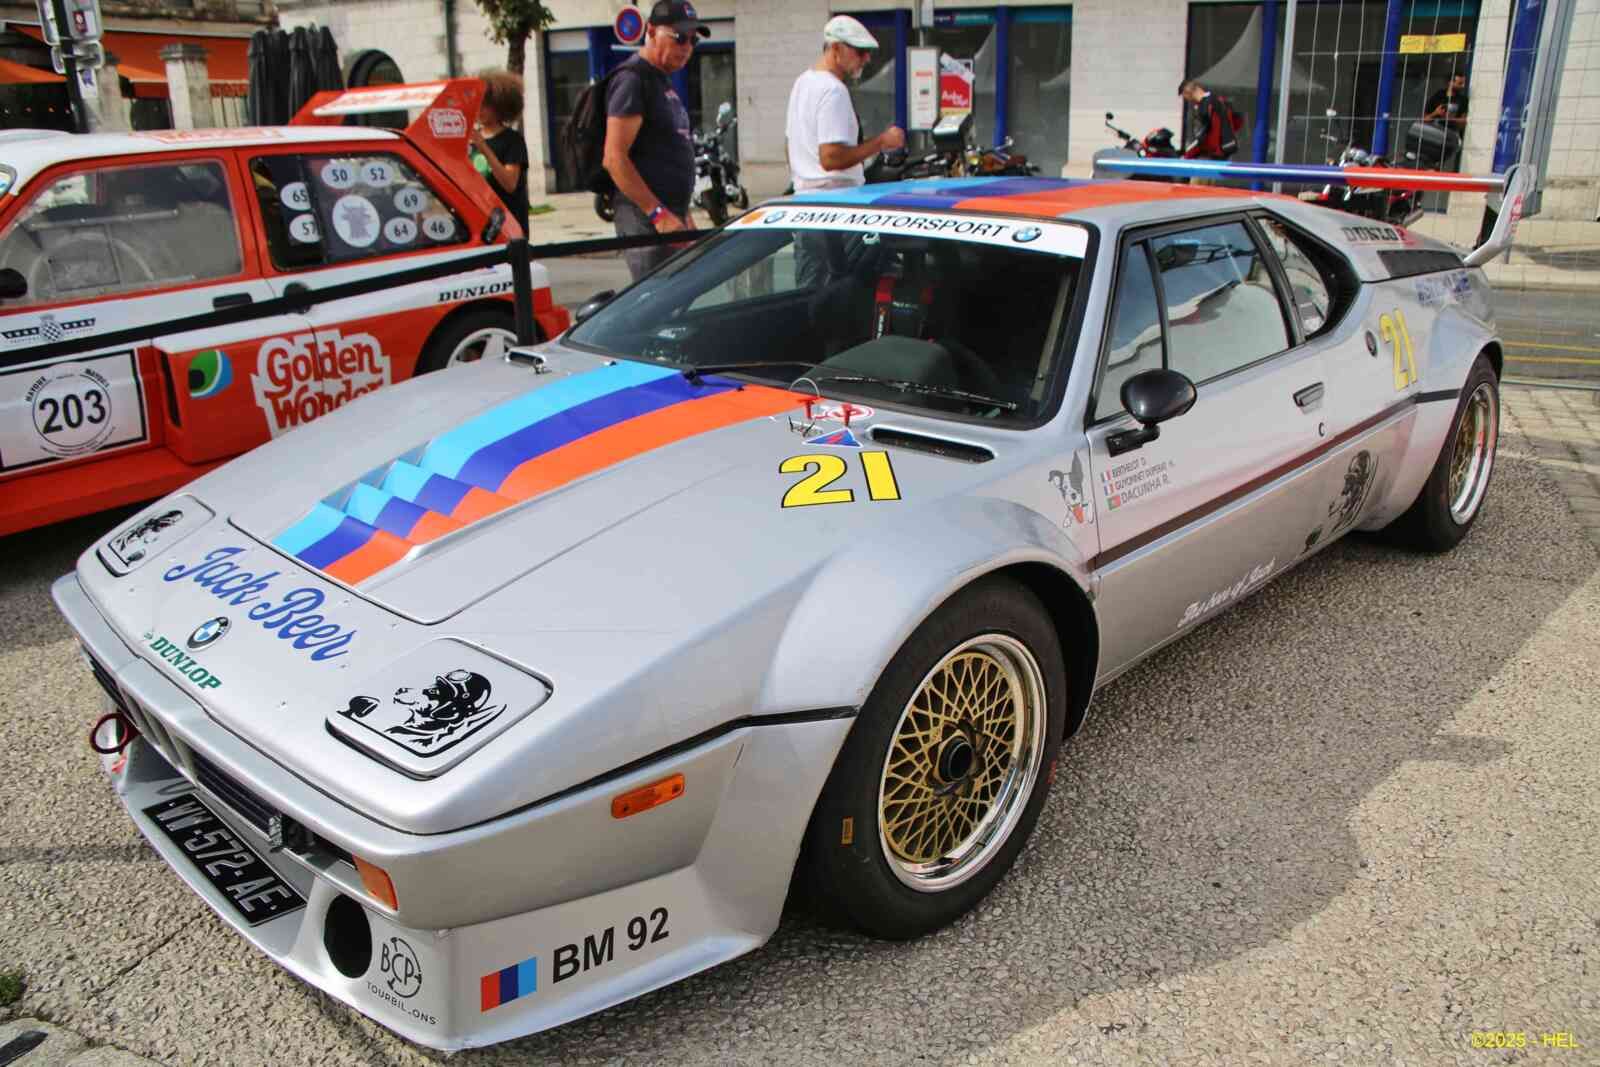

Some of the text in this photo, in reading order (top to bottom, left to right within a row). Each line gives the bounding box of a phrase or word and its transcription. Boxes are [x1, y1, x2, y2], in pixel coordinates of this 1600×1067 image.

[331, 169, 348, 182] 50
[369, 168, 385, 181] 52
[292, 189, 307, 202] 65
[403, 194, 418, 207] 69
[393, 223, 409, 235] 64
[430, 221, 446, 234] 46
[790, 211, 1010, 239] BMW MOTORSPORT
[438, 281, 513, 302] DUNLOP
[1378, 307, 1418, 392] 21
[267, 340, 384, 394] Golden
[38, 389, 106, 435] 203
[778, 450, 902, 509] 21
[163, 547, 357, 662] Jack Beer
[149, 636, 223, 690] DUNLOP
[552, 906, 670, 984] BM 92
